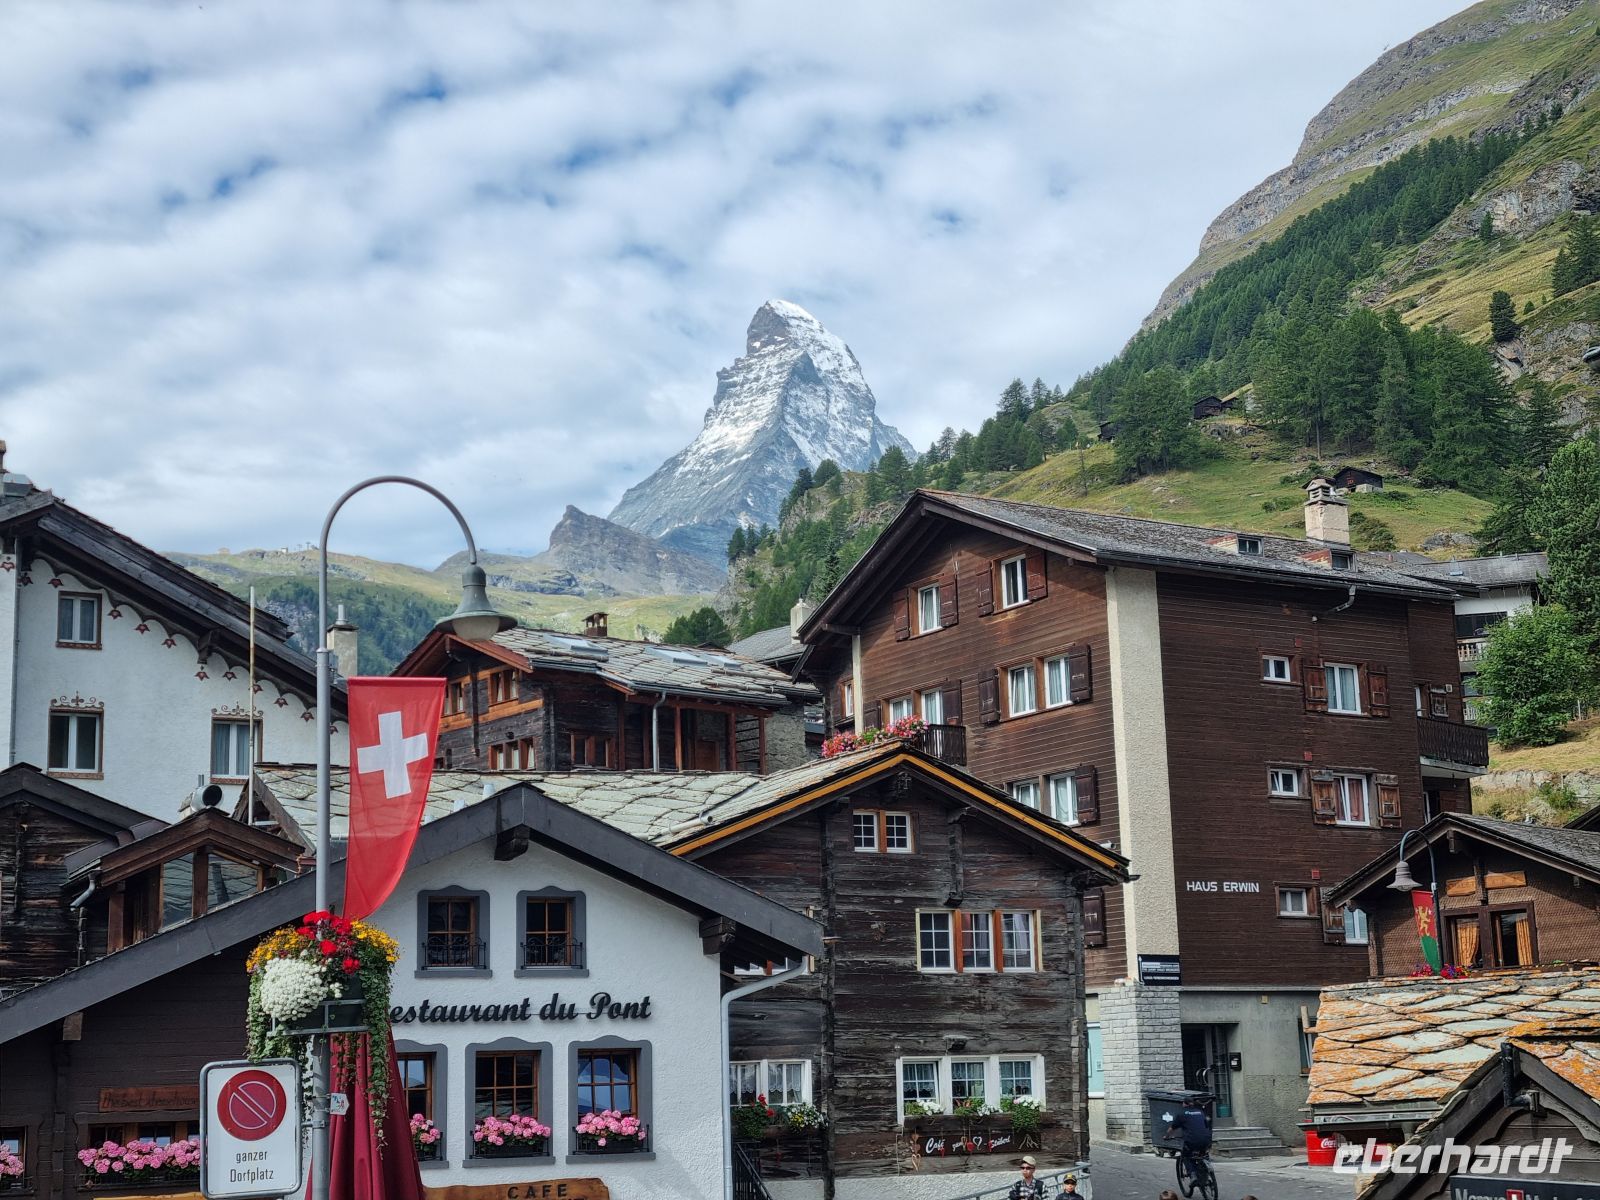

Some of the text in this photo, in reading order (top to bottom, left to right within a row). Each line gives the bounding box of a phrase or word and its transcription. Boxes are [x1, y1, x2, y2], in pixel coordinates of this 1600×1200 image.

[1186, 881, 1260, 893] HAUS ERWIN
[389, 992, 651, 1023] estaurant du Pont
[236, 1151, 267, 1164] ganzer
[230, 1167, 274, 1184] Dorfplatz
[507, 1184, 568, 1199] CAFE
